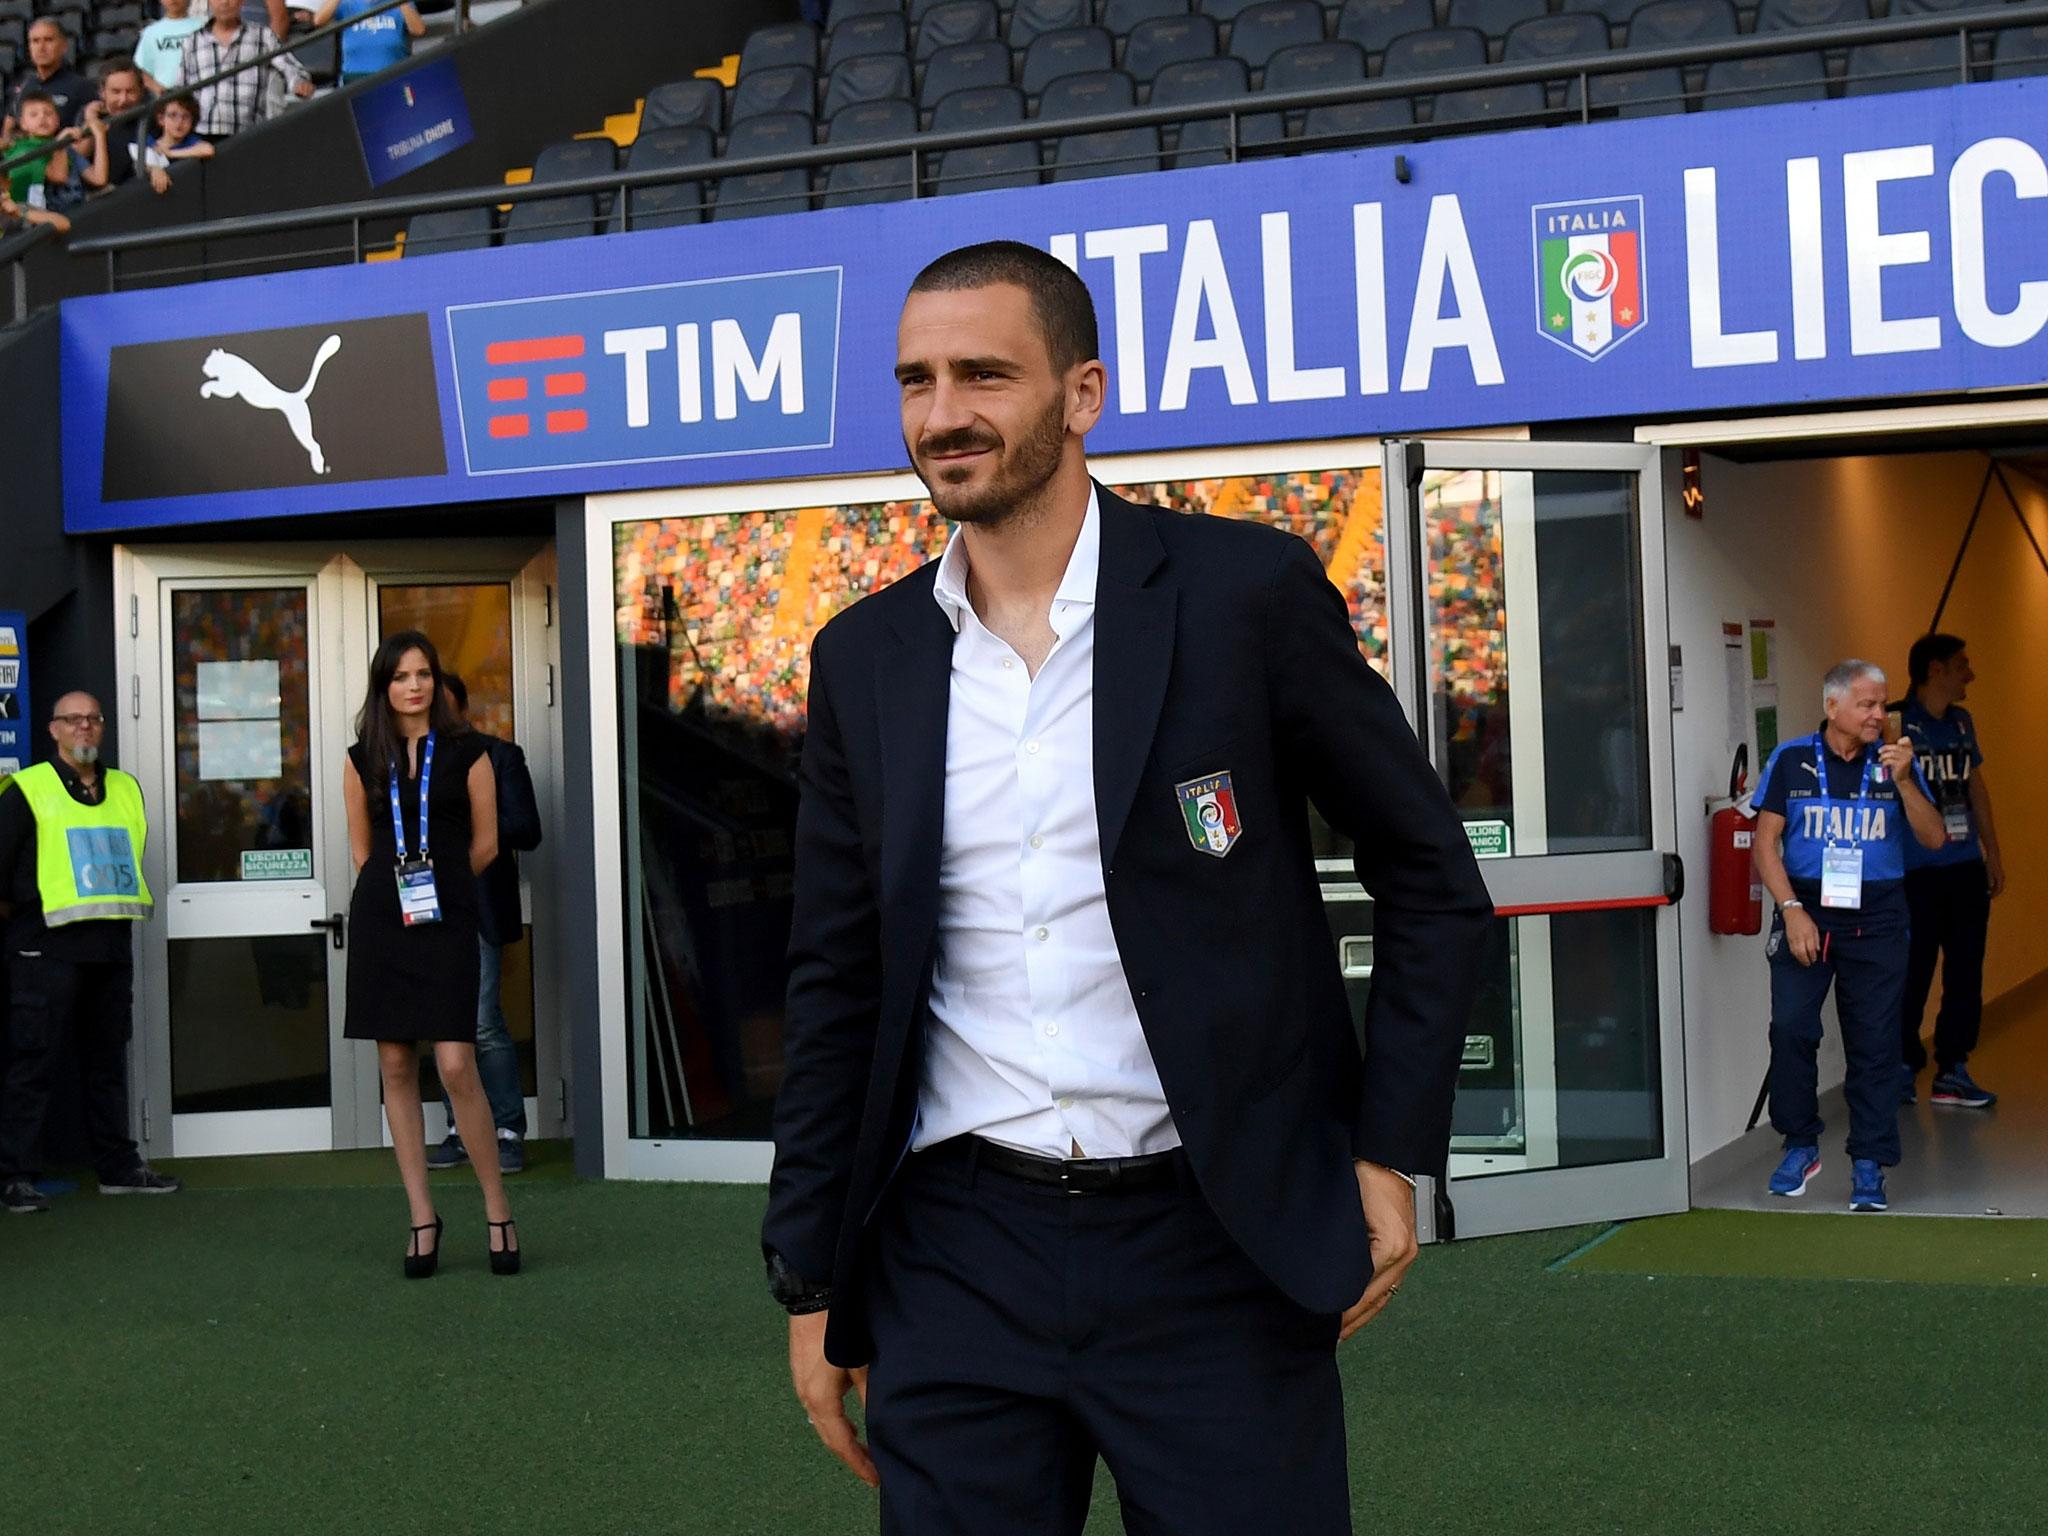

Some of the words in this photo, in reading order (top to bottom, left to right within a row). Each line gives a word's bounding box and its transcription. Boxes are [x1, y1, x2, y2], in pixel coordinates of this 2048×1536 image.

[156, 38, 183, 50] VAN
[388, 134, 423, 159] TRIBUNA
[1548, 210, 1626, 234] ITALIA
[1049, 194, 1506, 414] TALIA
[1684, 137, 2048, 368] LIEC
[604, 312, 804, 428] TIM
[1185, 780, 1220, 799] ITALIA
[1467, 826, 1501, 836] GLIONE
[1803, 806, 1886, 840] ITALIA
[1471, 836, 1501, 846] ANICO
[245, 861, 308, 870] SICUREZZA
[249, 852, 289, 861] USCITA
[293, 851, 304, 860] DI
